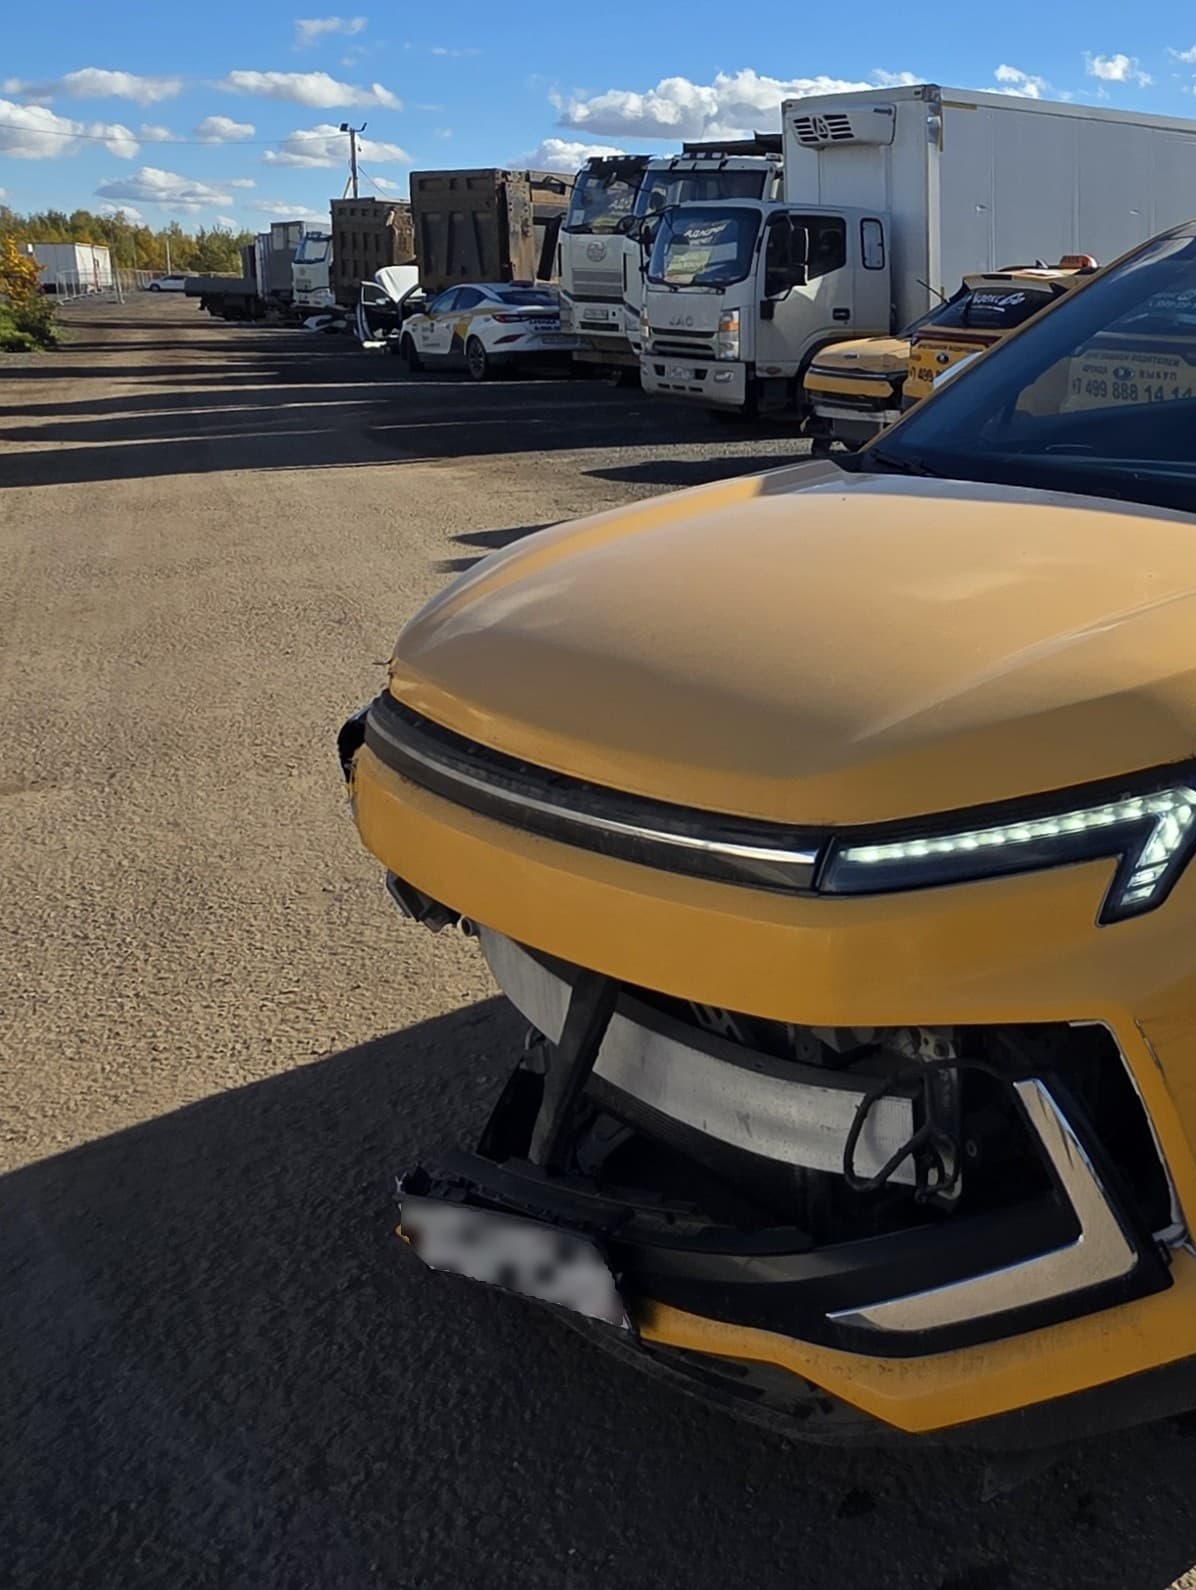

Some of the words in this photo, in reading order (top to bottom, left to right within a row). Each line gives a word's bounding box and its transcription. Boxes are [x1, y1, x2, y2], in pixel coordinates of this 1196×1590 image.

[1085, 379, 1108, 398] 499
[1112, 381, 1139, 401] 888
[1144, 384, 1165, 402] 14
[1171, 386, 1192, 399] 14
